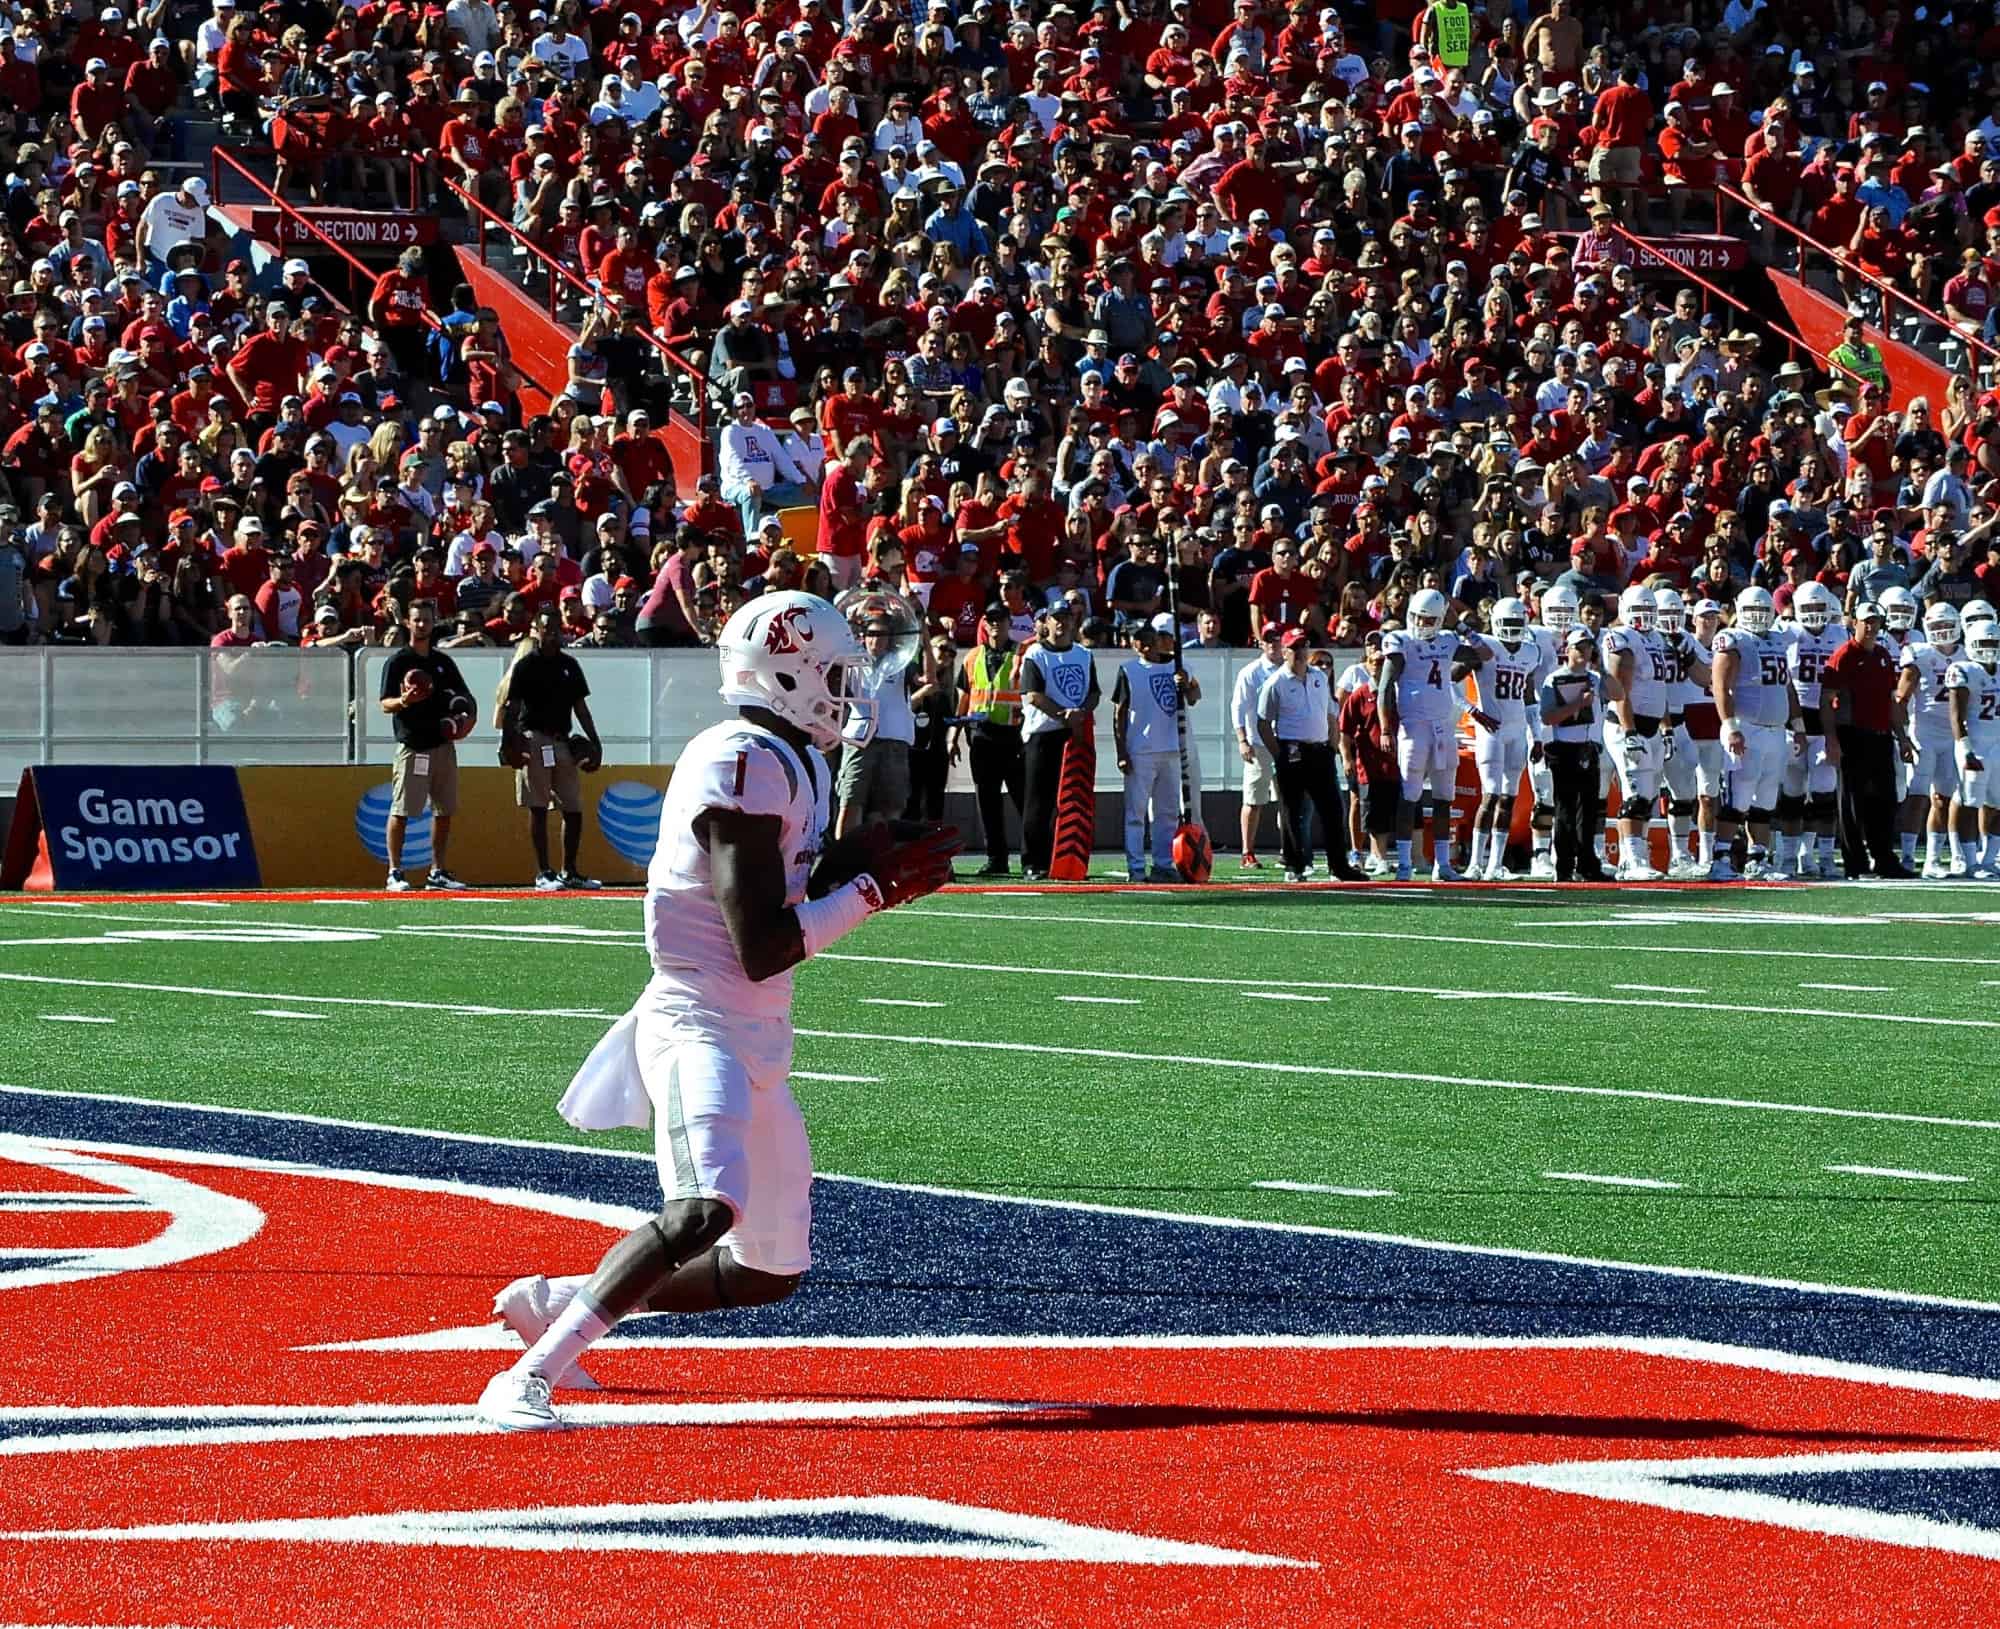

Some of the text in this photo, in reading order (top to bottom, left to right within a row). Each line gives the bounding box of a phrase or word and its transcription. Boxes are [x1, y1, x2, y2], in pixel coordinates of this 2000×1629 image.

[292, 220, 400, 242] 19 SECTION 20
[1640, 247, 1696, 268] SECTION
[1698, 248, 1713, 268] 21
[1427, 660, 1442, 690] 4
[1496, 669, 1525, 700] 80
[1760, 656, 1788, 685] 58
[1068, 686, 1081, 697] 12
[78, 788, 206, 826] Game
[60, 825, 241, 871] Sponsor
